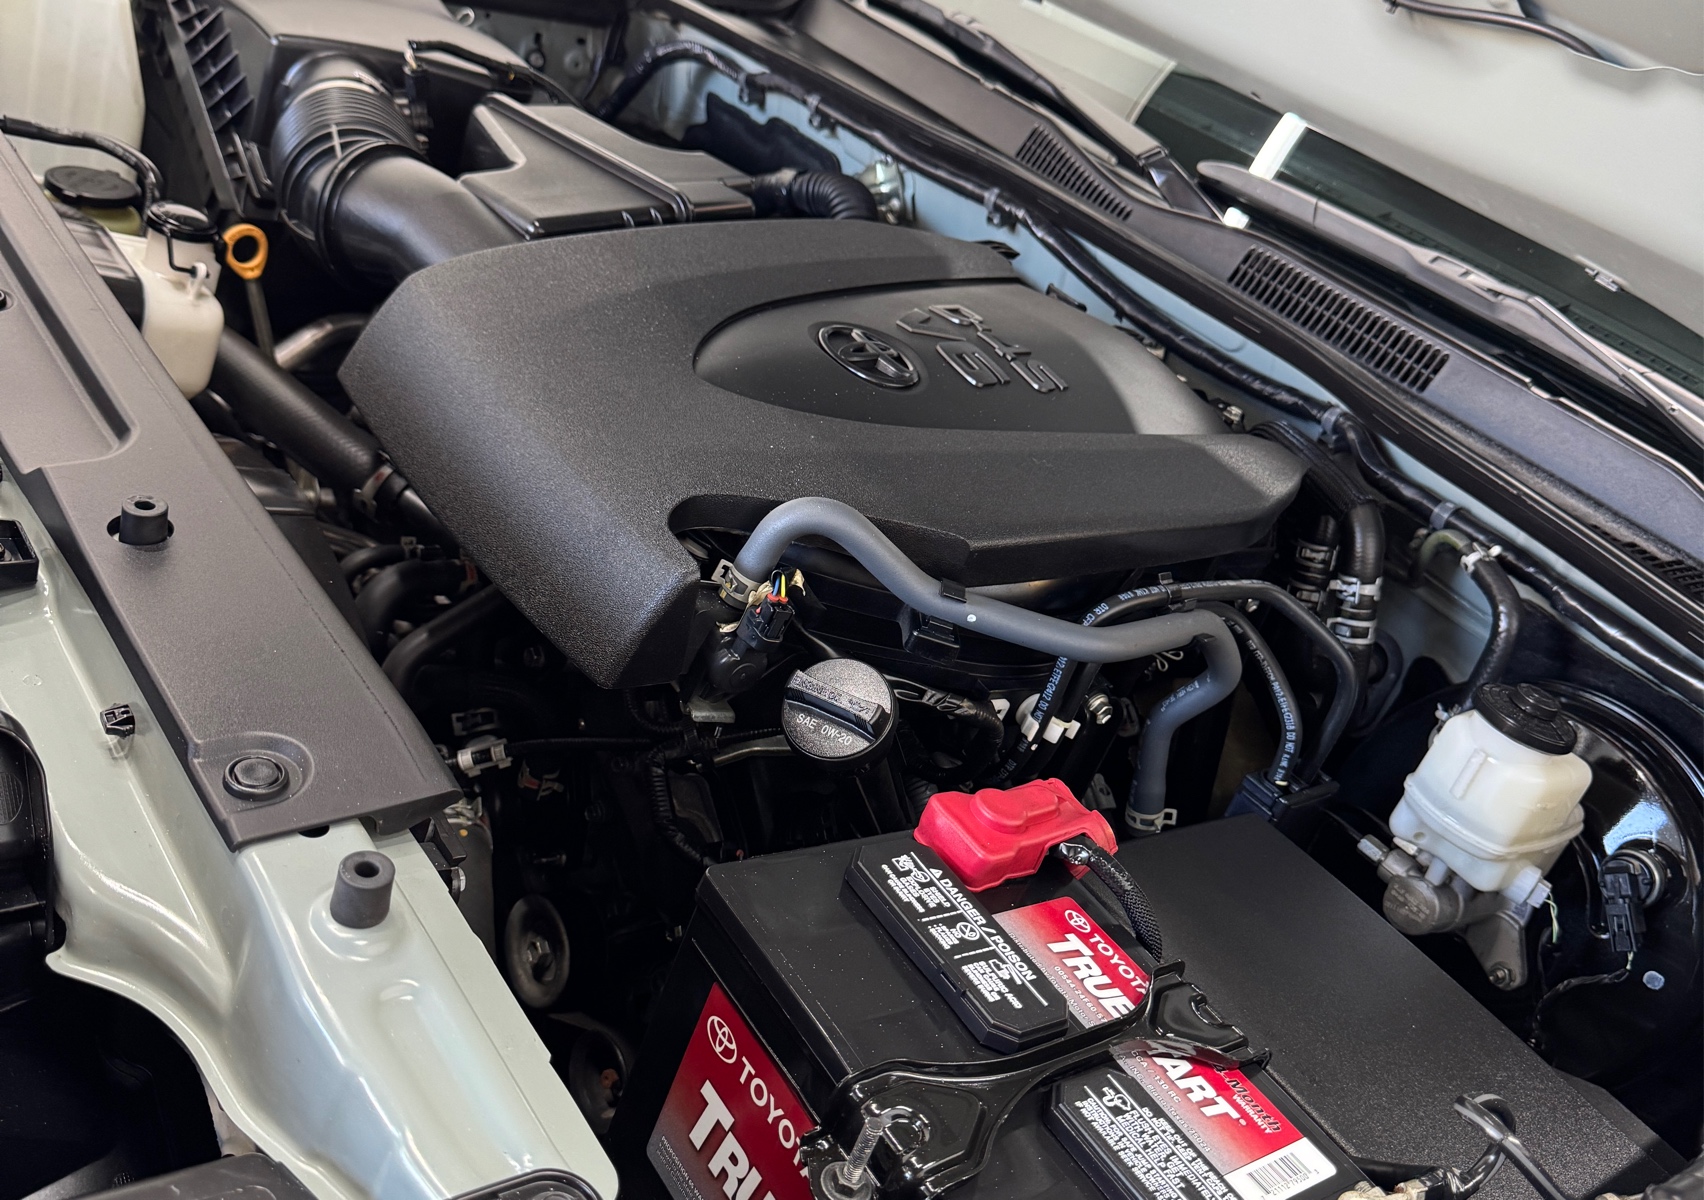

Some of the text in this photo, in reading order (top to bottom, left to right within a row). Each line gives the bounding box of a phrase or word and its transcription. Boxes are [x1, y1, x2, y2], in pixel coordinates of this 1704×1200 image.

[796, 713, 853, 746] SAE 0W-20
[939, 878, 987, 925] DANGER
[989, 934, 1037, 980] POISON
[1047, 933, 1135, 1018] TRUE
[1131, 1050, 1148, 1067] CCA
[1154, 1075, 1169, 1090] 130
[1167, 1090, 1181, 1103] RC
[740, 1056, 809, 1178] TOYO
[1128, 1109, 1154, 1134] FLUSH
[1150, 1133, 1172, 1154] EYES
[1141, 1106, 1153, 1117] DO
[1150, 1116, 1166, 1131] NOT
[1172, 1133, 1188, 1147] OUT
[1189, 1128, 1211, 1152] 75024
[1232, 1094, 1273, 1134] WARRANTY
[1080, 1108, 1095, 1121] NOT
[1117, 1150, 1134, 1166] SEEK
[1130, 1166, 1156, 1191] SERVICE
[1115, 1115, 1185, 1189] MEDICAL HELP FAST
[1121, 1137, 1137, 1152] SAFE
[1150, 1169, 1178, 1198] STARTING
[1123, 1113, 1143, 1131] WITH
[1165, 1161, 1184, 1177] GET
[1123, 1148, 1148, 1173] VEHICLE
